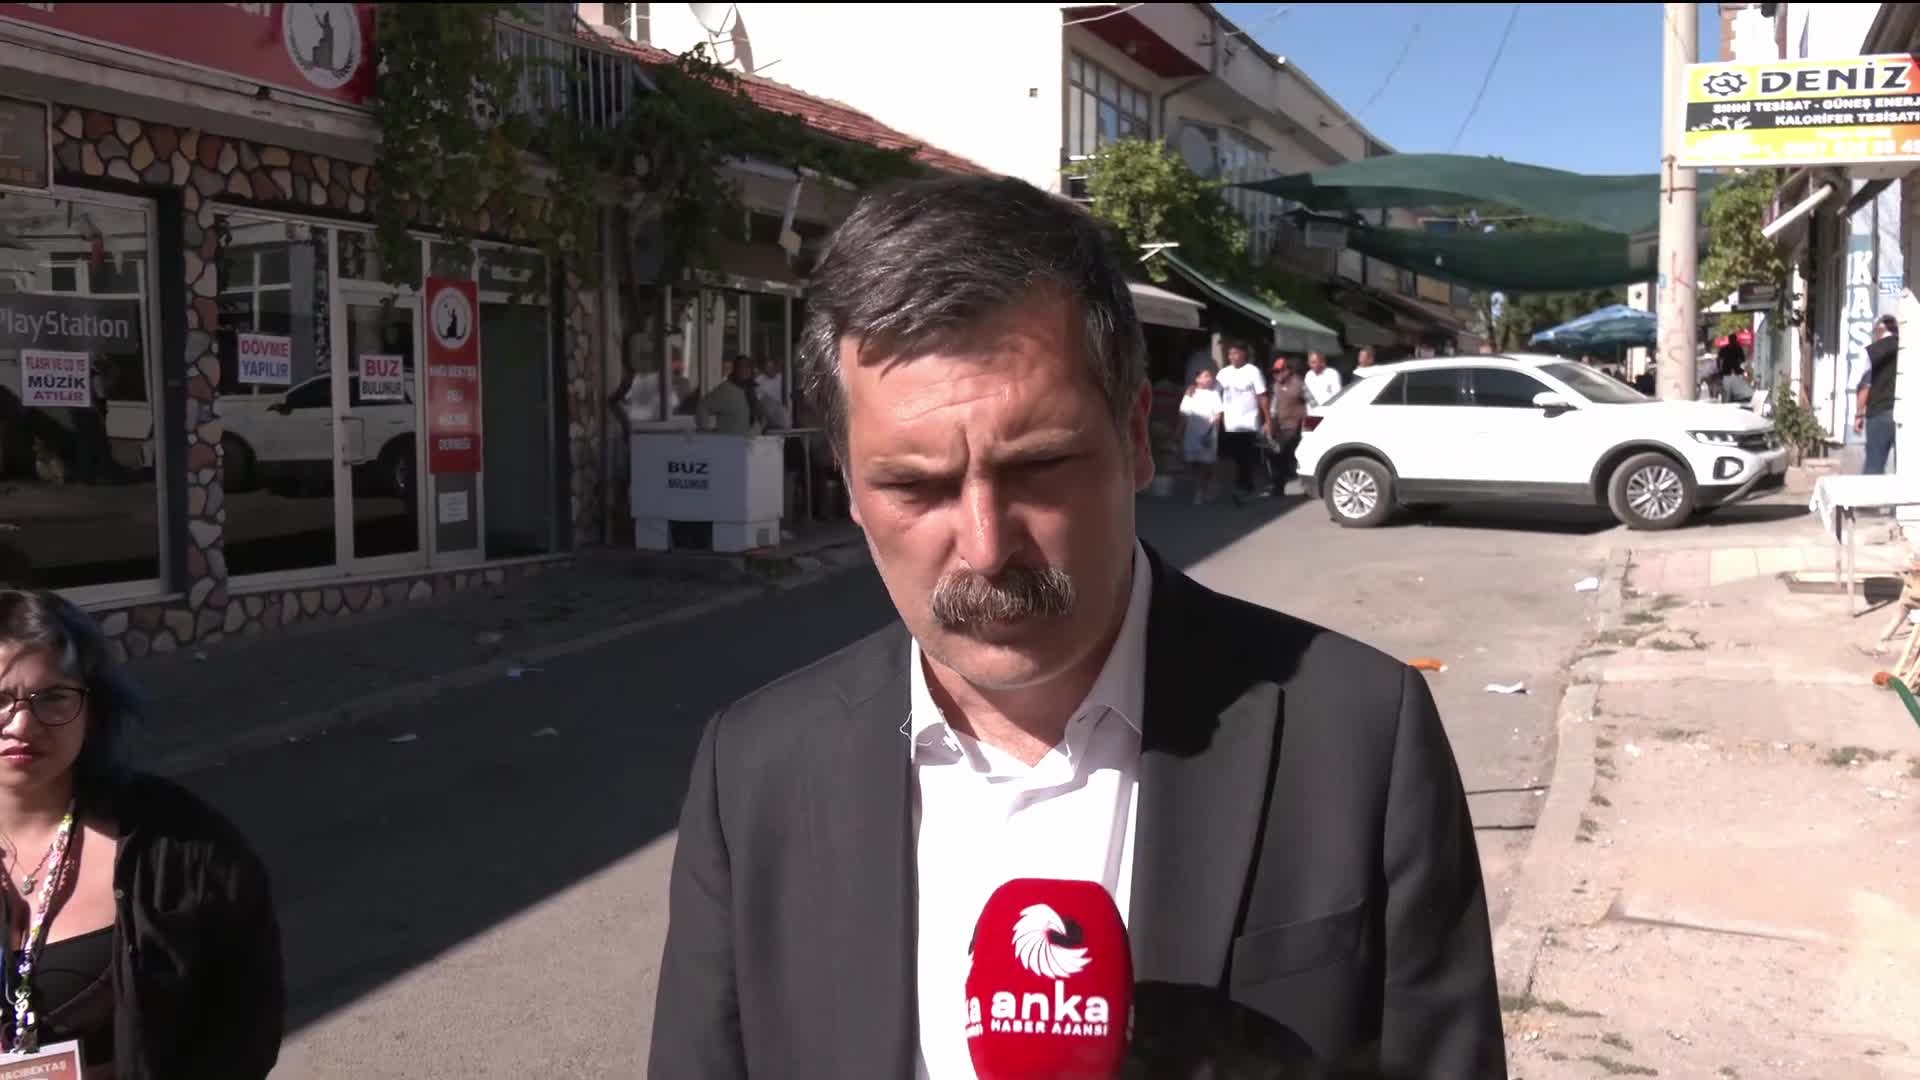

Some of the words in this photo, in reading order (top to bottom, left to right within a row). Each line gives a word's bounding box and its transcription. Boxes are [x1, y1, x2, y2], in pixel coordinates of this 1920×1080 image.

[1761, 62, 1910, 93] DENİZ
[1755, 99, 1812, 113] TESİSAT
[1822, 97, 1872, 110] GÜNEŞ
[1775, 113, 1854, 126] KALORİFER
[1857, 110, 1920, 123] TESİSATI
[240, 340, 289, 358] DÖVME
[242, 360, 288, 377] YAPILIR
[366, 359, 400, 376] BUZ
[28, 374, 86, 389] MÜZİK
[667, 461, 709, 474] BUZ
[991, 980, 1109, 1023] anka
[991, 1019, 1046, 1034] HABER
[1051, 1023, 1109, 1037] AJANSI
